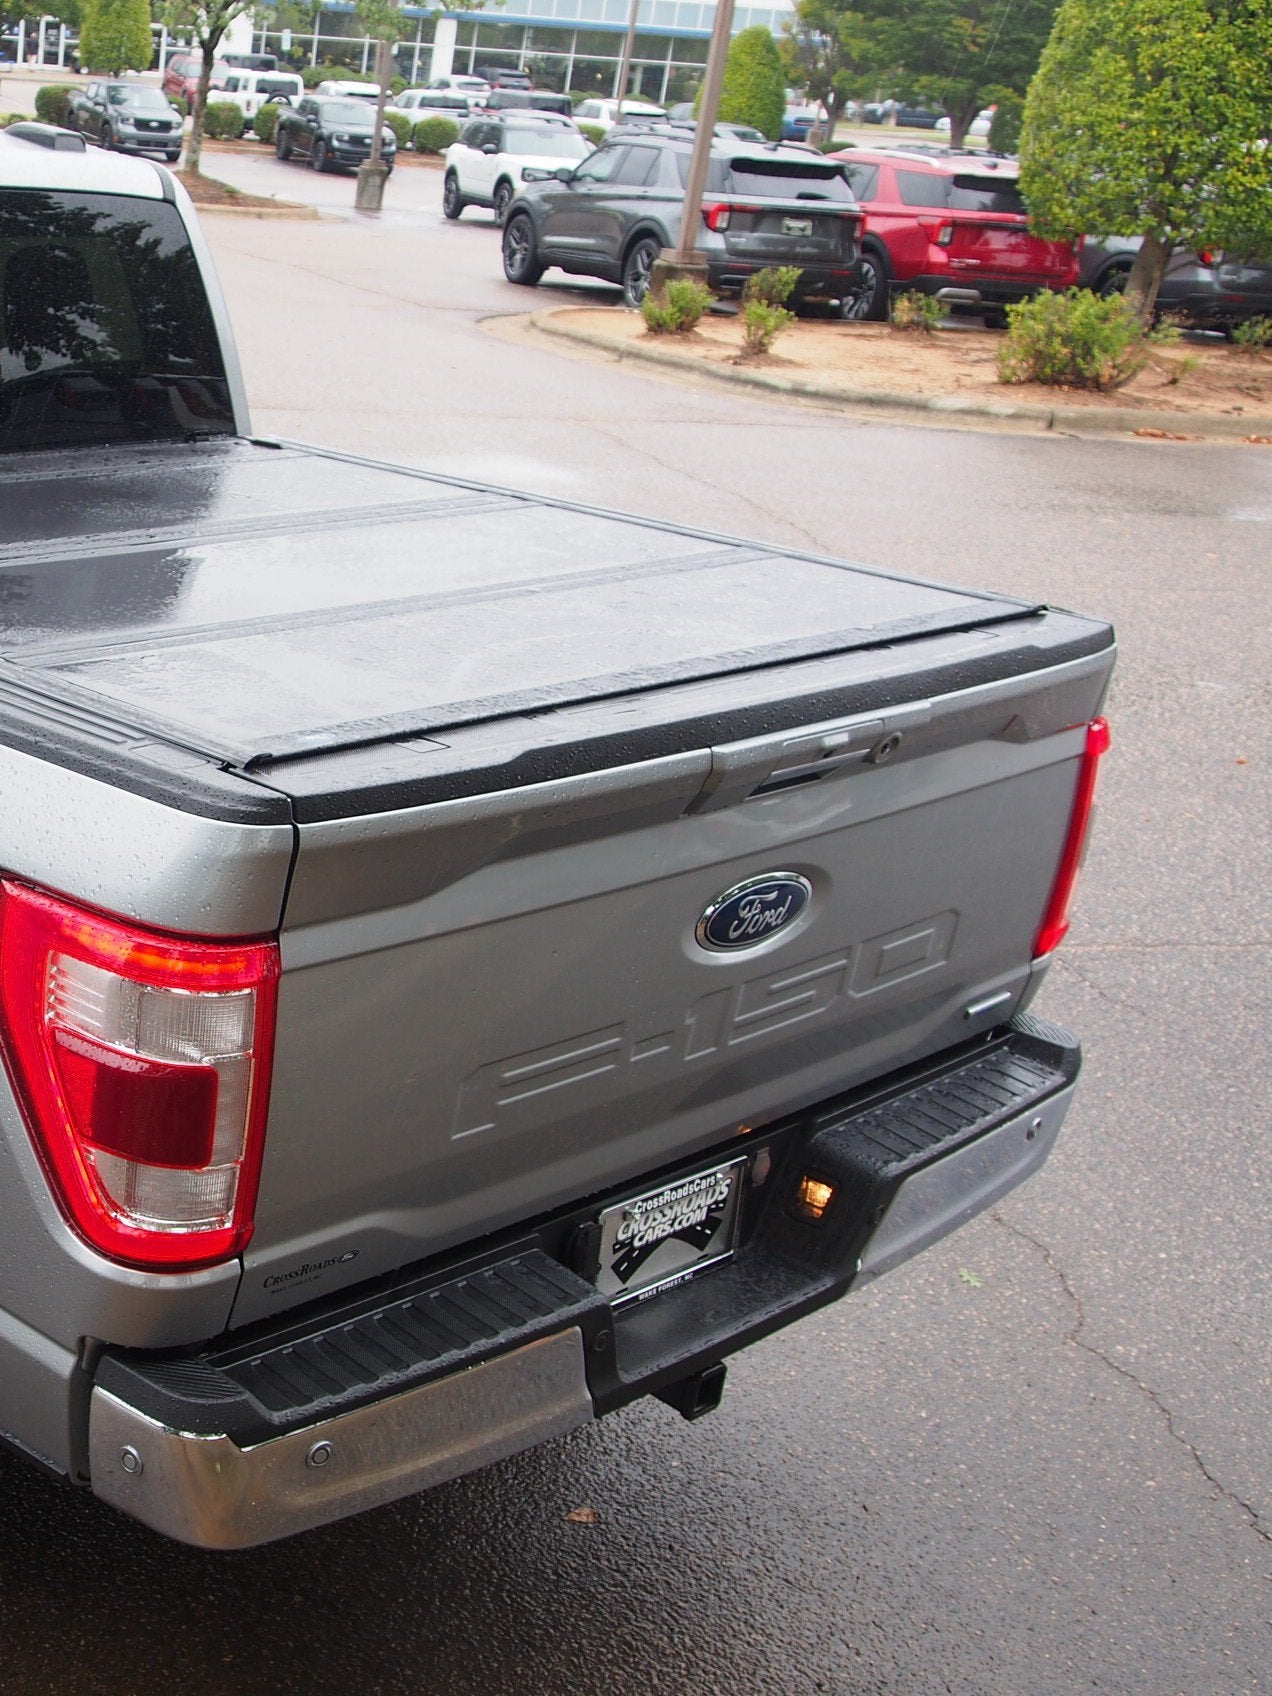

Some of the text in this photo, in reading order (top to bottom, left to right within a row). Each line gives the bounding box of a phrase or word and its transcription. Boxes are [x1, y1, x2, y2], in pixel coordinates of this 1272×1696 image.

[728, 890, 792, 939] Ford
[451, 908, 960, 1140] F-150
[617, 1178, 732, 1242] CROSSROADS
[632, 1205, 708, 1249] CARS.COM
